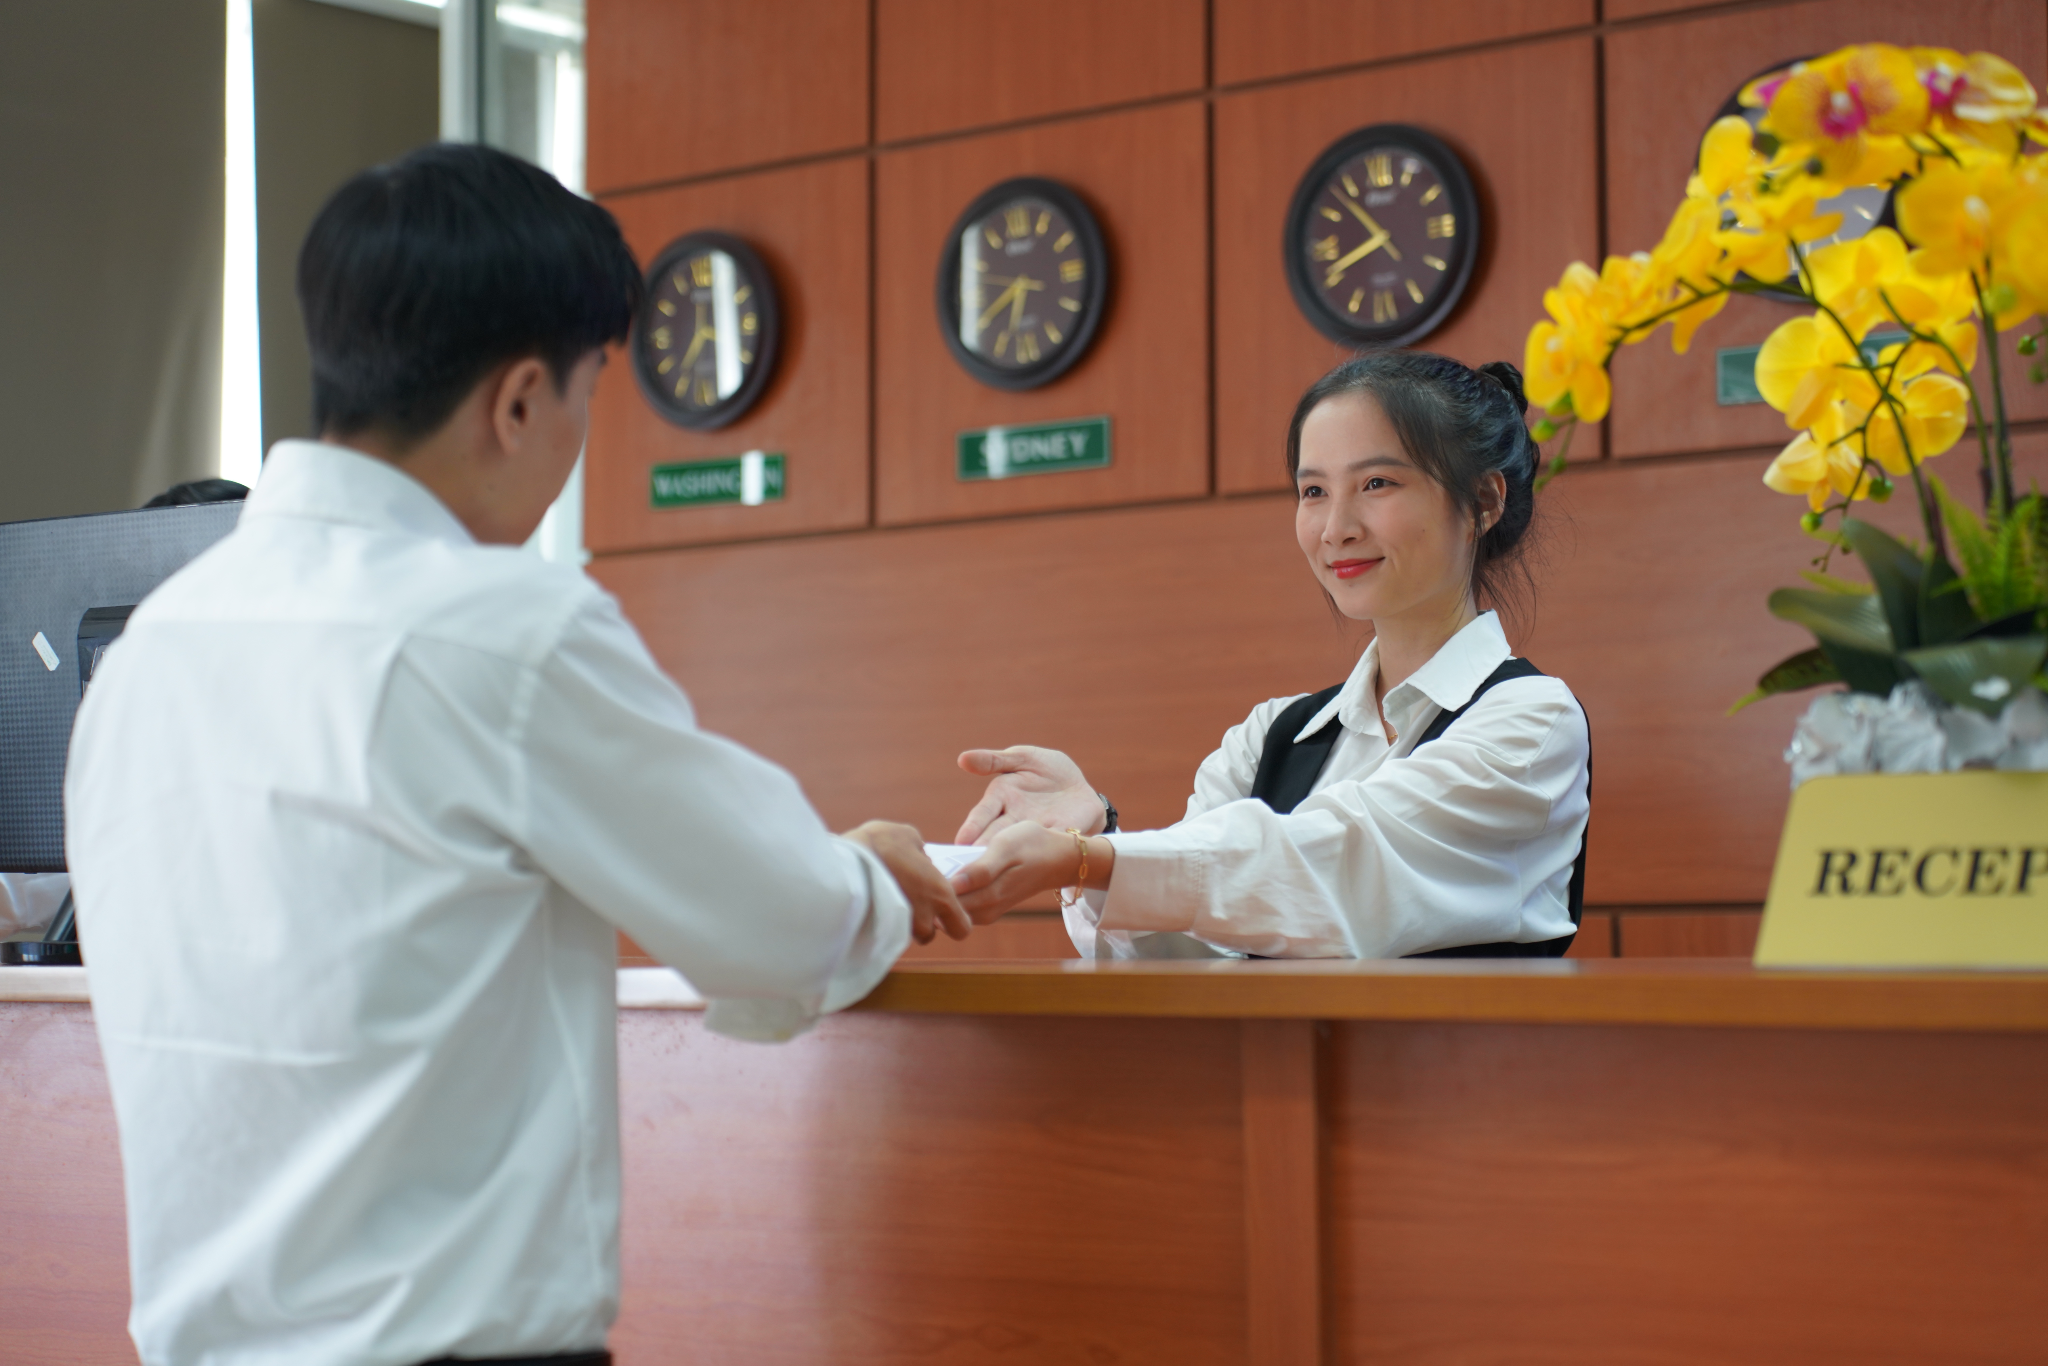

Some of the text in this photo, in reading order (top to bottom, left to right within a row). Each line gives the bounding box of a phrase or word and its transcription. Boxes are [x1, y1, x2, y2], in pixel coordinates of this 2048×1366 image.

[978, 428, 1090, 468] SDNEY
[653, 464, 782, 499] WASHINGN
[1807, 845, 2048, 899] RECEP
